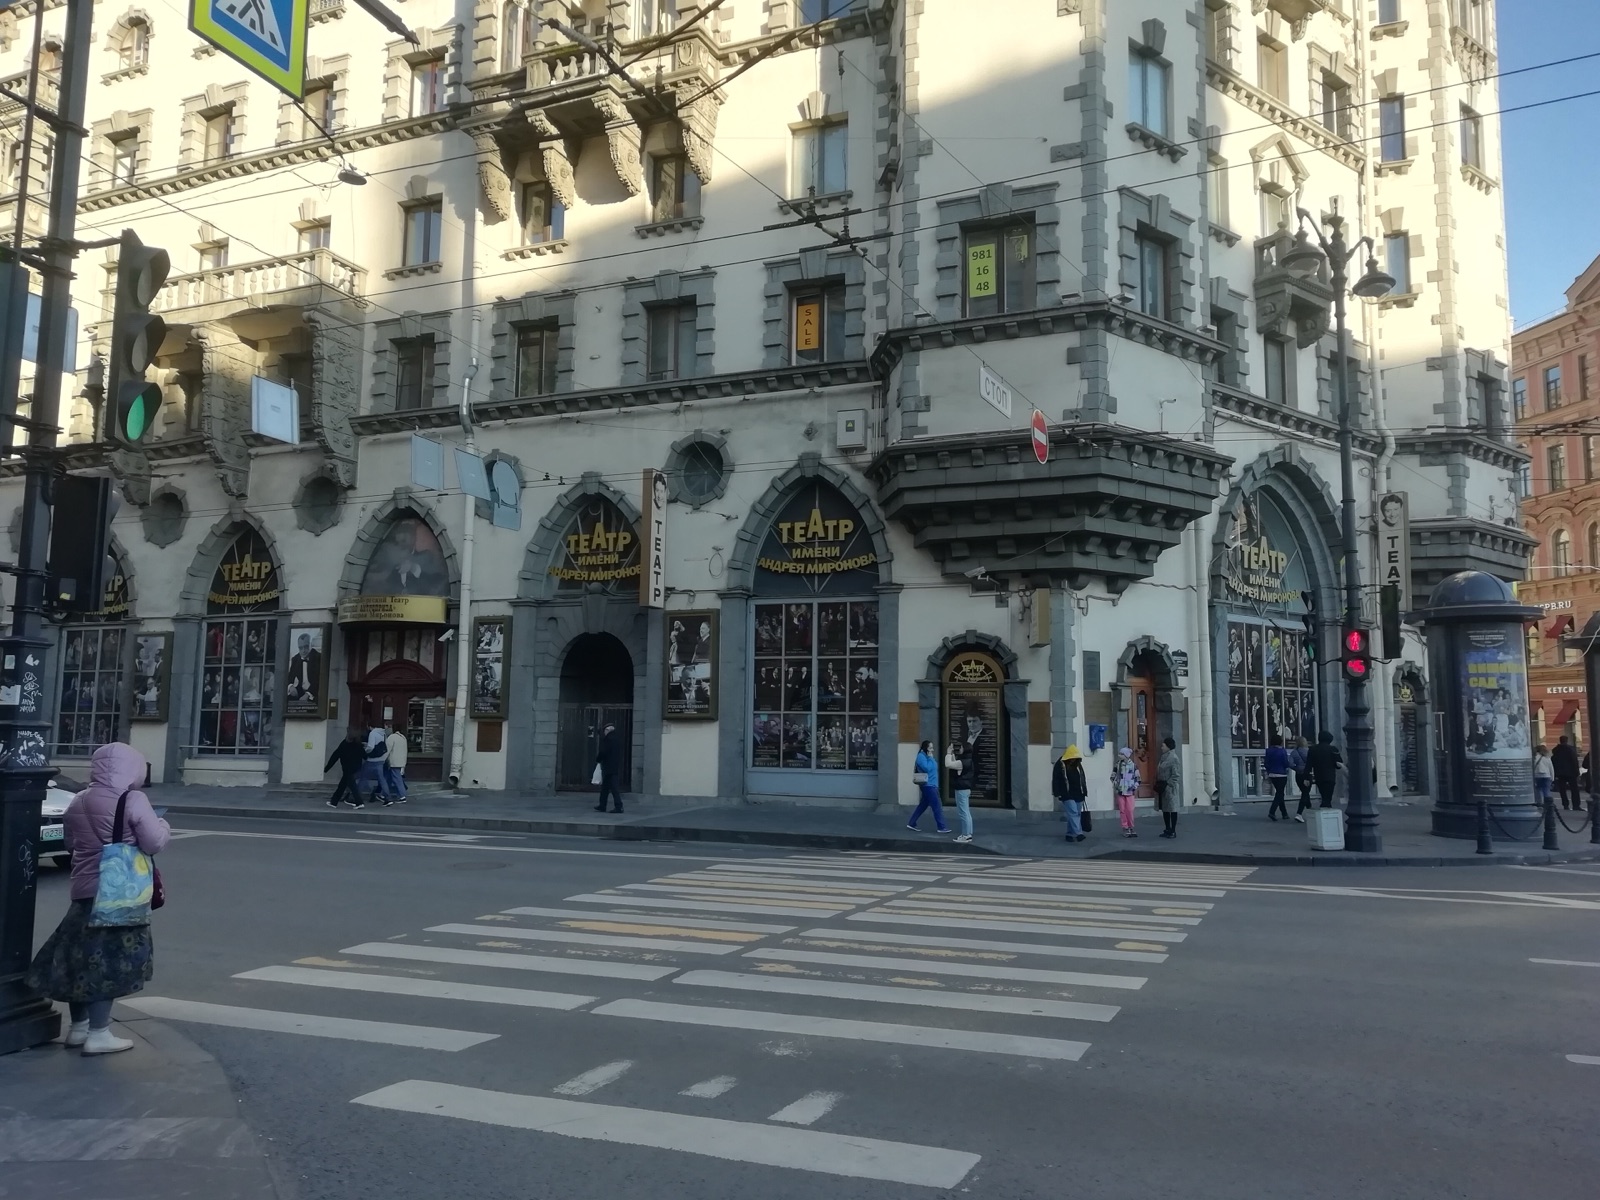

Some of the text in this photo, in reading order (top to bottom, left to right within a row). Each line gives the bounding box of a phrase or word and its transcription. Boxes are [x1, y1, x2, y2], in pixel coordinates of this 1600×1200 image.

[971, 249, 992, 261] 981
[975, 265, 989, 276] 16
[975, 280, 990, 292] 48
[803, 308, 813, 346] SALE
[984, 376, 1008, 410] СТОП
[778, 508, 854, 544] ТЕАТР
[567, 522, 632, 555] ТЕАТР
[577, 553, 619, 566] ИМЕНИ
[652, 519, 663, 602] ТЕАТР
[792, 546, 840, 559] ИМЕНИ
[1240, 535, 1288, 574] ТЕАТР
[1387, 535, 1401, 586] ТЕА
[222, 553, 272, 582] ТЕАТР
[548, 564, 641, 581] АНДРЕЯ МИРОНОВ
[757, 552, 877, 574] АНДРЕЯ МИРОНОВА
[229, 581, 262, 591] ИМЕНИ
[1228, 575, 1301, 603] АНДРЕЯ МИРОНОВА
[1249, 573, 1281, 589] ИМЕНИ
[239, 588, 279, 605] МИРОНОВ
[1546, 686, 1574, 694] KETCH
